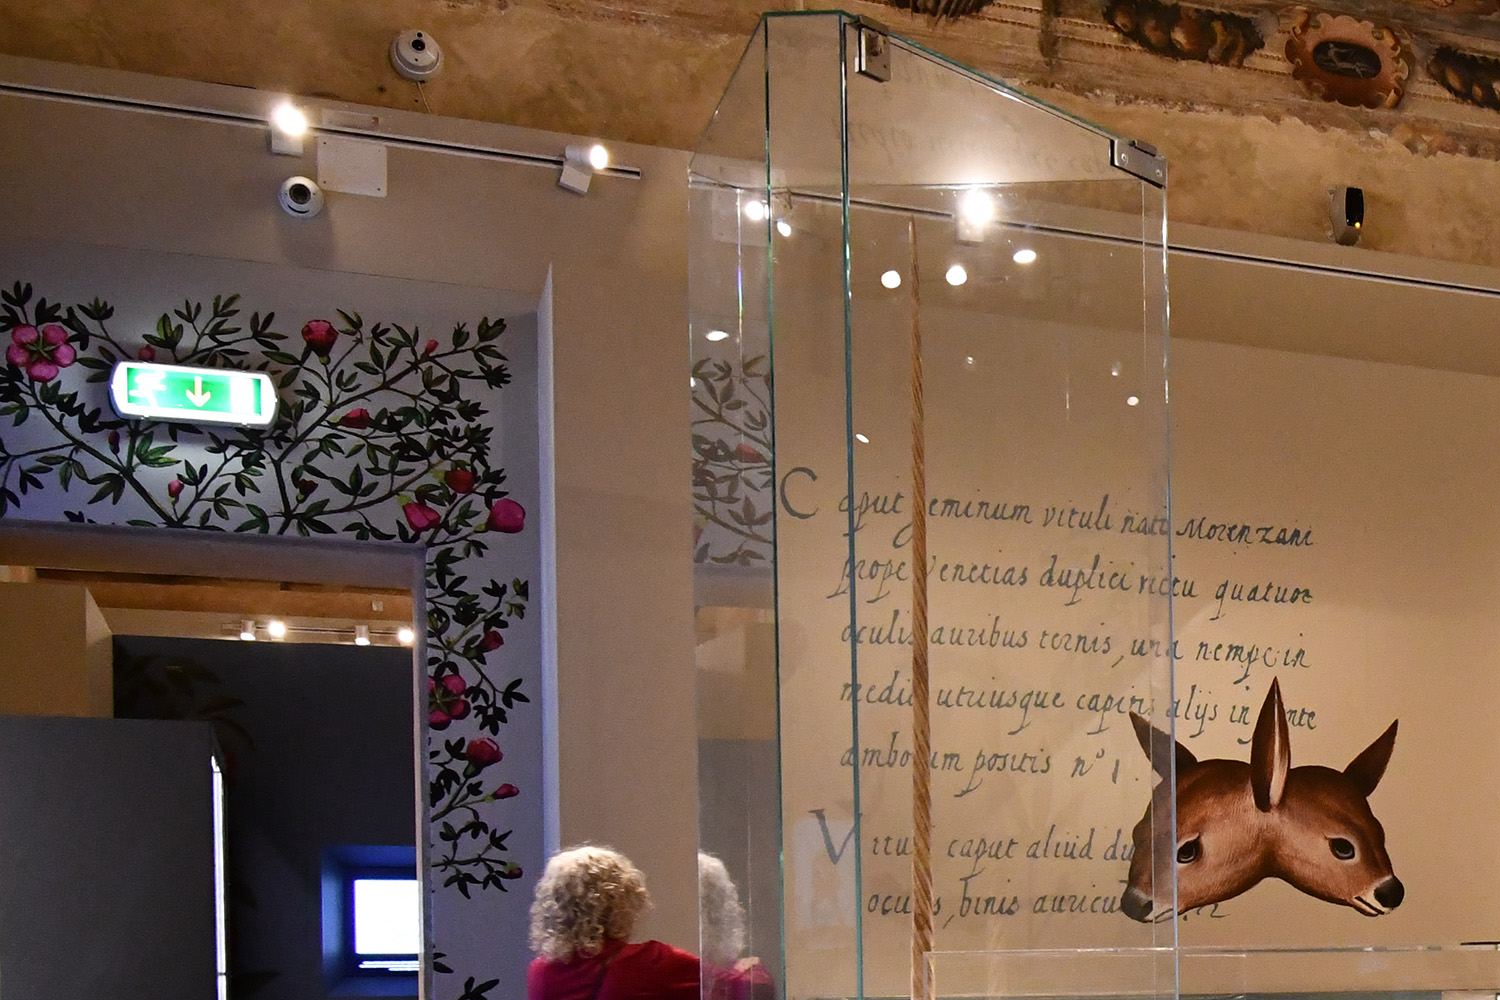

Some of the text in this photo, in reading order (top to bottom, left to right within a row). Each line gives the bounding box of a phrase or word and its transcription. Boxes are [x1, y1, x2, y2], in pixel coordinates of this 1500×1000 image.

[893, 487, 1033, 549] eminum
[1042, 493, 1113, 531] vituli
[1040, 554, 1133, 607] duplici
[1209, 579, 1314, 622] quatuor
[930, 613, 1028, 648] auribus
[947, 837, 1018, 882] caput
[1025, 824, 1095, 861] aliud
